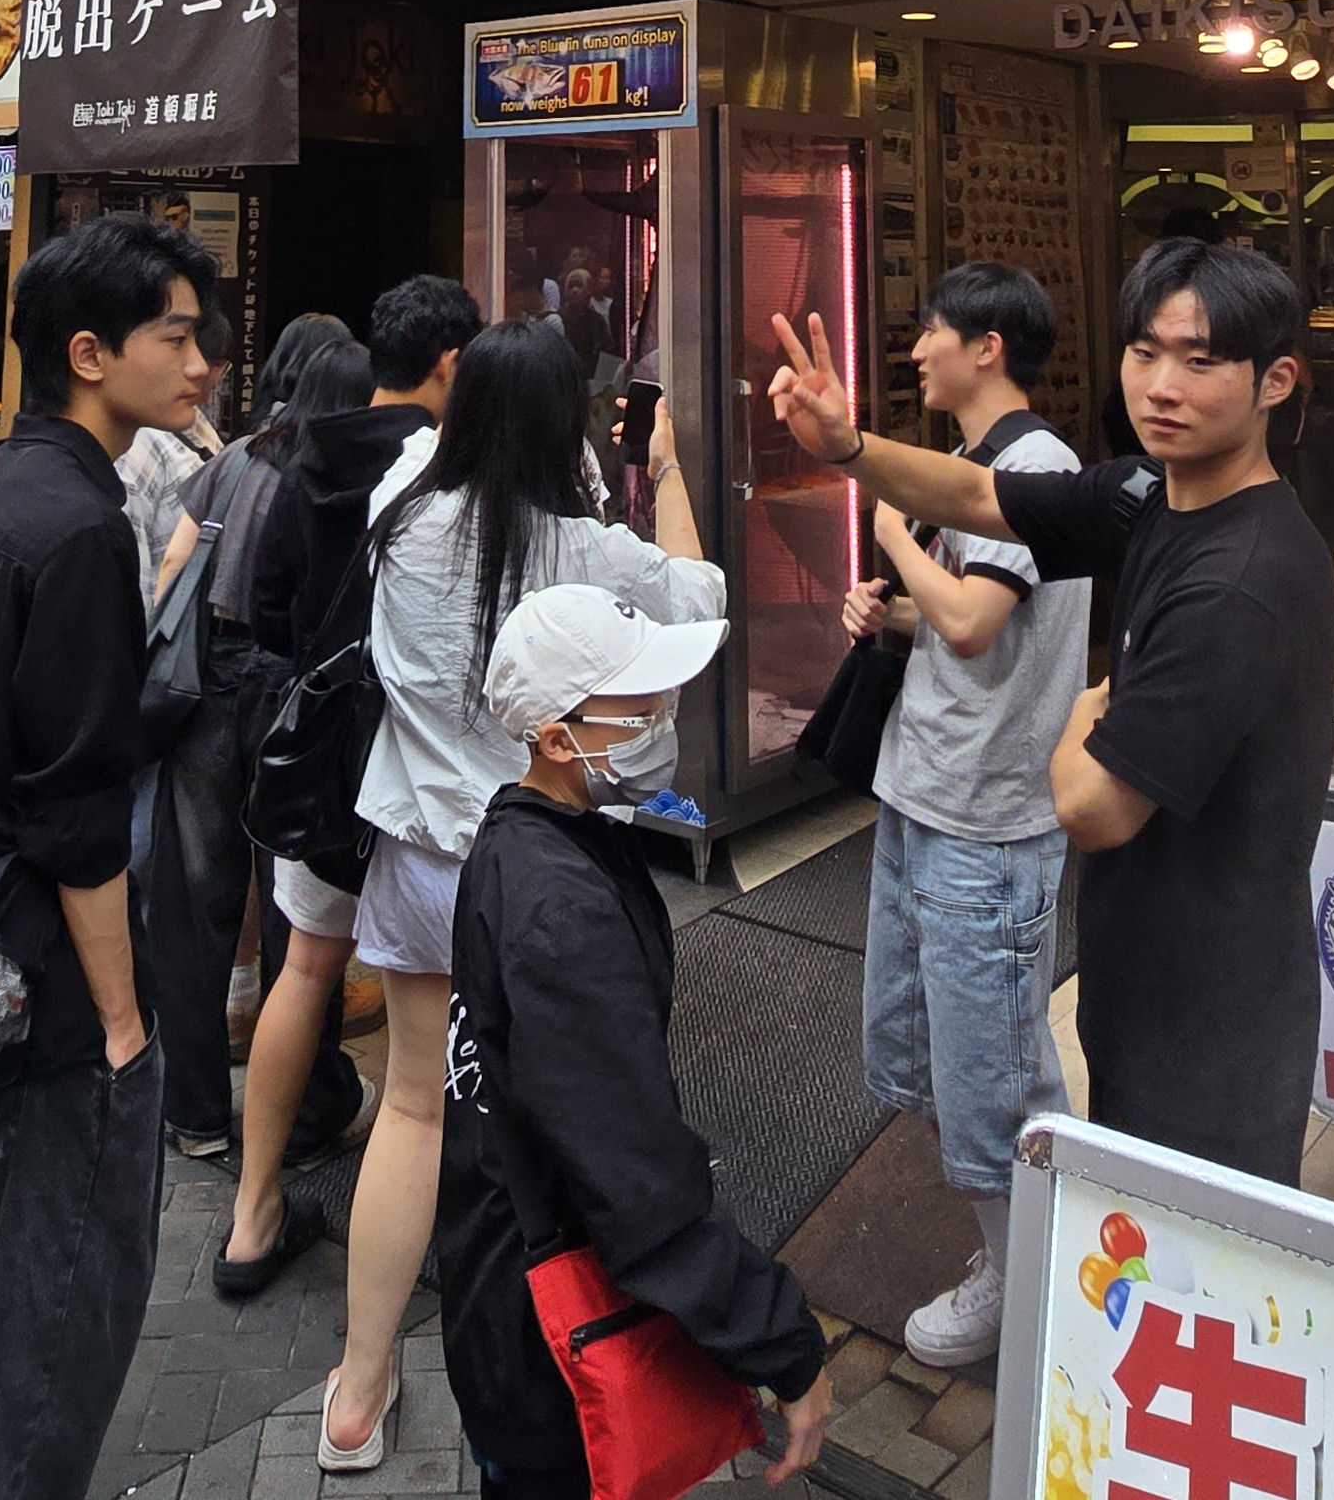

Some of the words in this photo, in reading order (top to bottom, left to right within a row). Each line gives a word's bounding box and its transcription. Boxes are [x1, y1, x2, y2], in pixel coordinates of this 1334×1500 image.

[516, 40, 537, 56] The
[540, 36, 579, 54] Bluefin
[582, 34, 609, 49] tuna
[612, 34, 628, 48] on
[632, 27, 677, 47] display
[571, 64, 613, 105] 61
[96, 100, 115, 117] Toki
[117, 98, 137, 117] Toki
[144, 90, 218, 125] 道頓堀店
[500, 99, 525, 113] now
[528, 95, 568, 113] weighs
